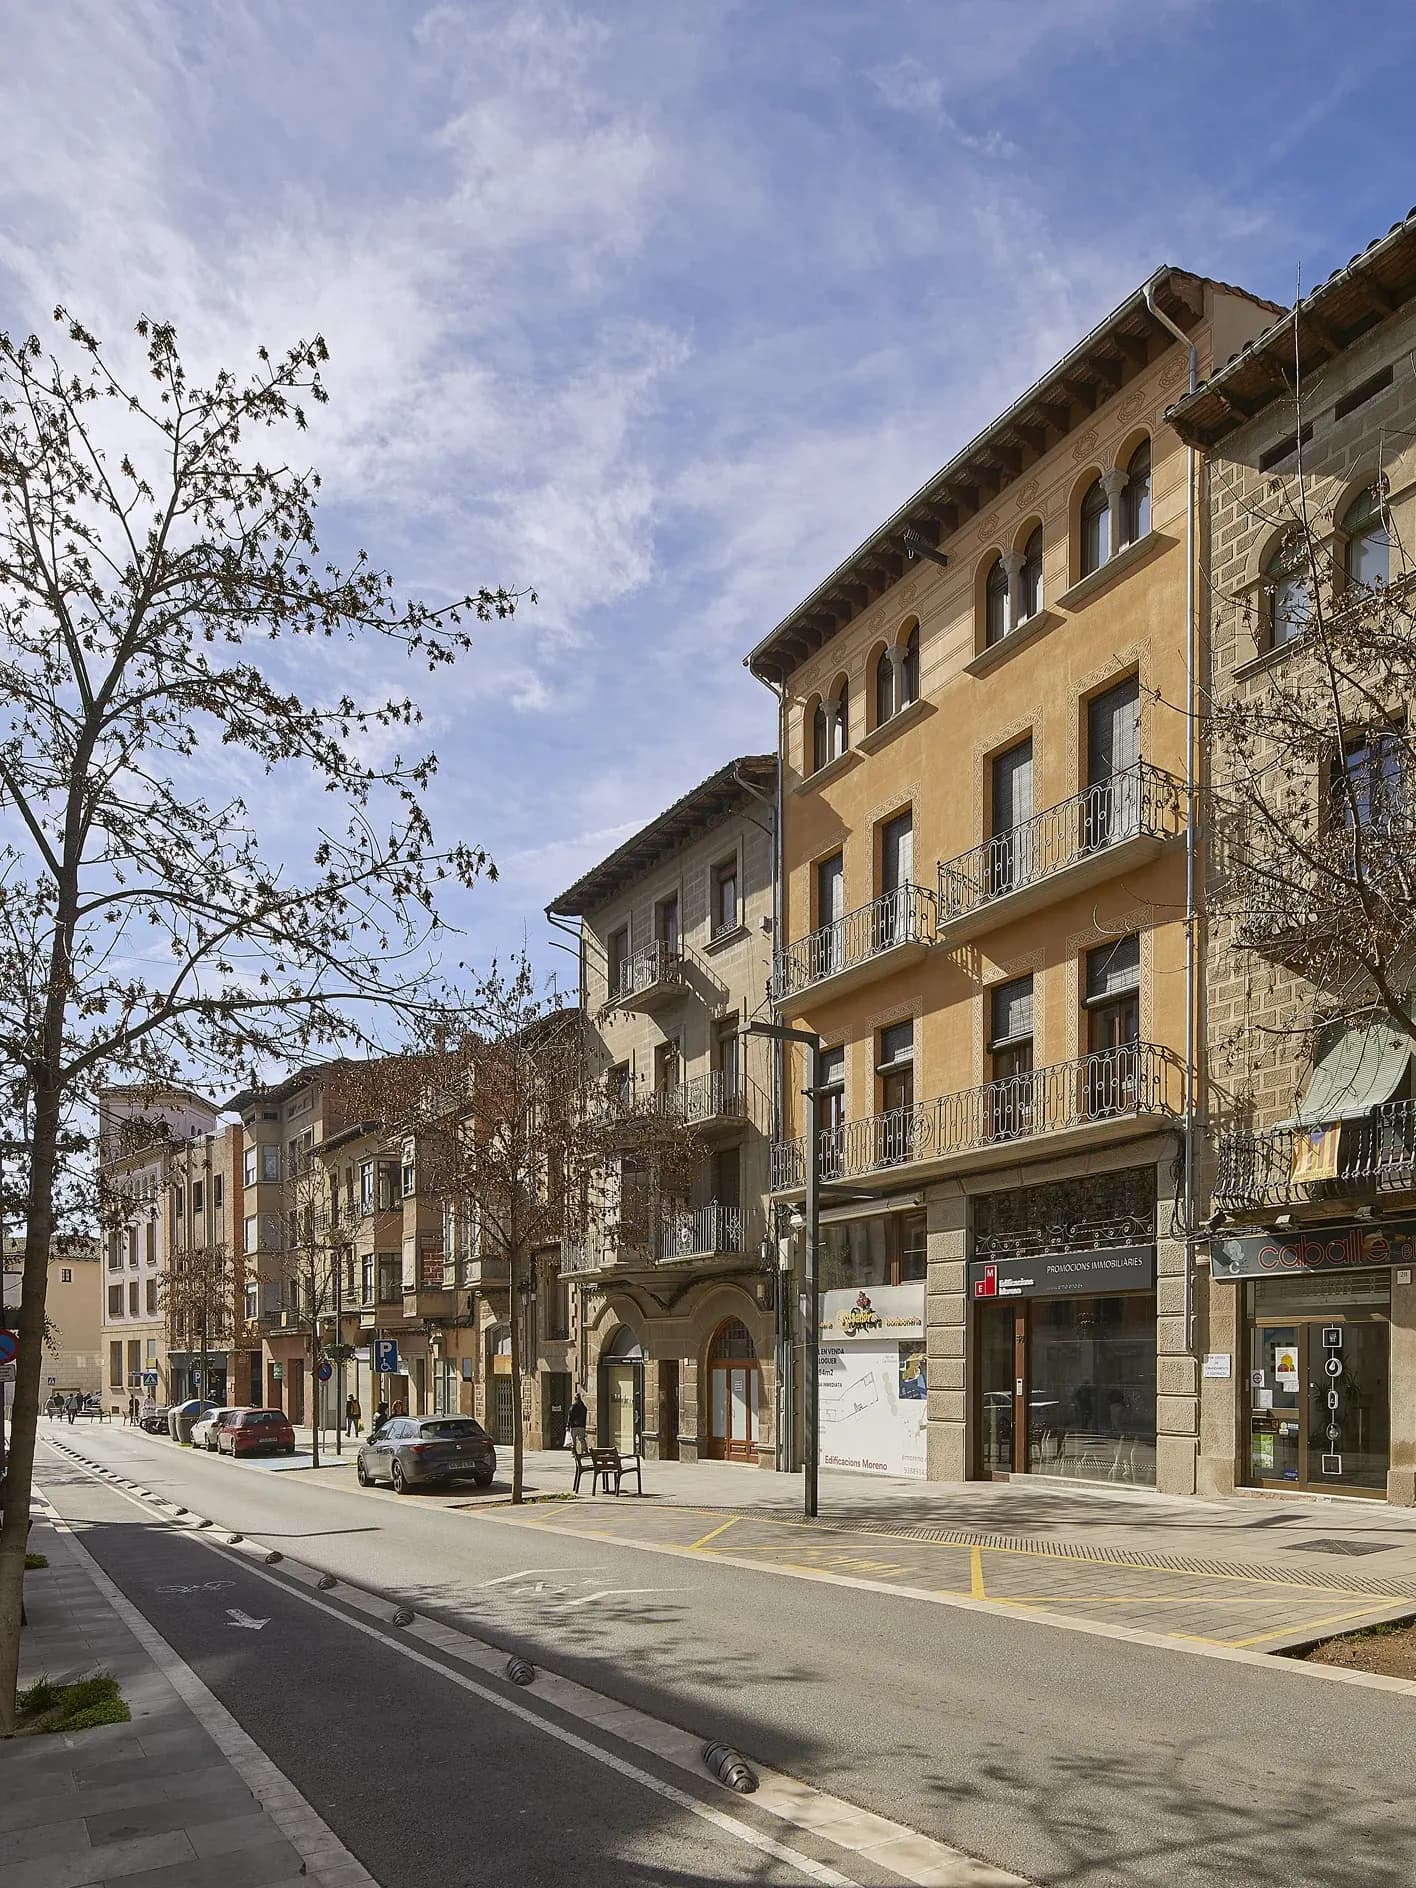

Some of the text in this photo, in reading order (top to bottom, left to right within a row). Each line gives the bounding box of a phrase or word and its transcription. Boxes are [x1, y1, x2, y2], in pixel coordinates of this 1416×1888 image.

[986, 1269, 994, 1277] M
[1046, 1263, 1090, 1274] PROMOCIONS
[978, 1285, 984, 1293] E
[380, 1342, 392, 1357] P
[824, 1455, 861, 1468] Edificacions
[862, 1458, 888, 1471] Moreno
